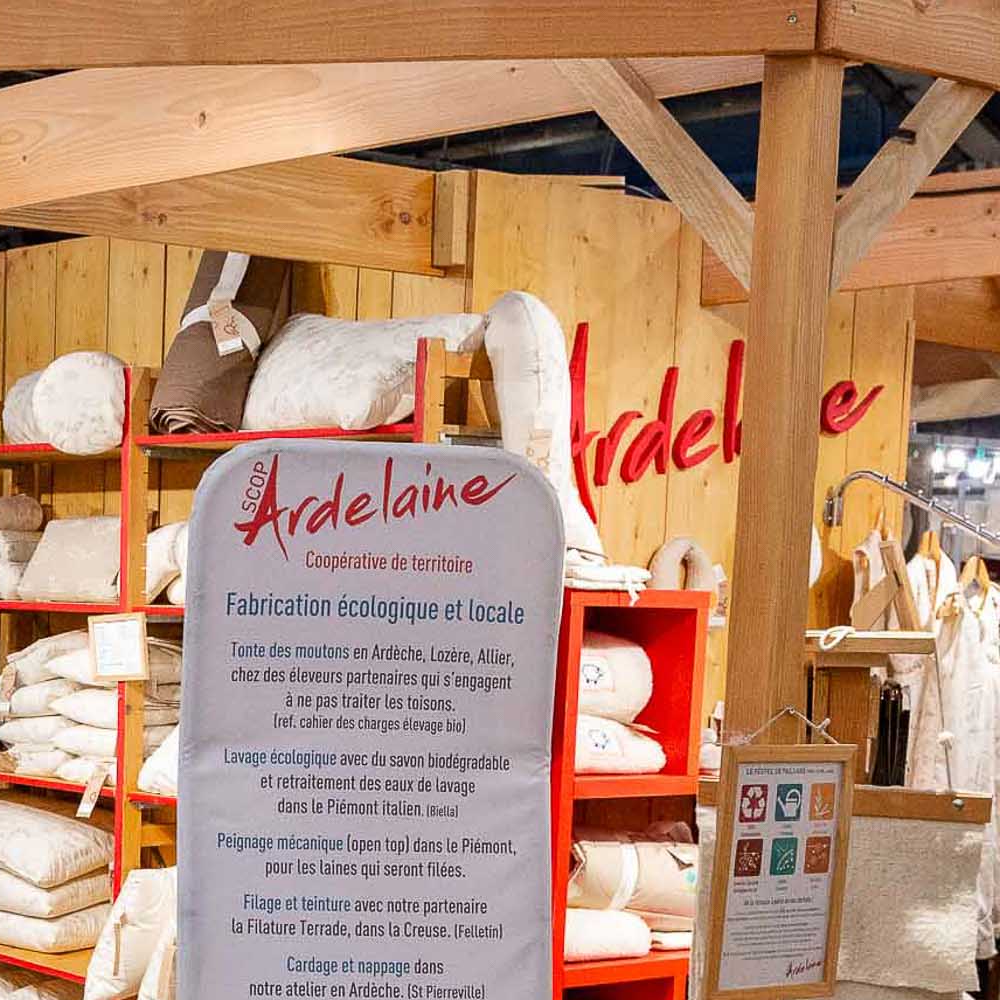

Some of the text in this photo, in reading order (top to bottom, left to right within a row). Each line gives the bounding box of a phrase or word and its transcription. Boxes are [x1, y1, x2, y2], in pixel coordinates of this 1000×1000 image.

[569, 322, 884, 524] Ardele
[242, 461, 268, 514] SCOP
[234, 453, 517, 561] Ardelaine
[306, 550, 473, 574] Coopérative de territoire
[227, 592, 524, 625] Fabrication écologique et locale
[231, 641, 514, 668] Tonte des moutons en Ardèche, Lozère, Allier,
[231, 666, 512, 693] chez des éleveurs partenaires qui s'engagent
[286, 691, 455, 712] à ne pas traiter les toisons.
[300, 714, 334, 729] cahier
[336, 715, 355, 730] des
[358, 716, 400, 733] charges
[403, 717, 443, 735] élevage
[224, 748, 510, 773] Lavage écologique avec du savon biodégradable
[260, 774, 475, 797] et retraitement des eaux de lavage
[278, 797, 308, 814] dans
[312, 798, 323, 814] le
[327, 798, 379, 816] Piémont
[382, 800, 424, 817] italien.
[218, 832, 516, 856] Peignage mécanique (open top) dans le Piémont,
[265, 858, 466, 880] pour les laines qui seront filées.
[244, 894, 487, 917] Filage et teinture avec notre partenaire
[232, 917, 243, 934] la
[247, 918, 296, 936] Filature
[300, 919, 351, 939] Terrade,
[355, 920, 385, 937] dans
[389, 921, 400, 938] la
[402, 921, 451, 940] Creuse.
[287, 956, 444, 978] Cardage et nappage dans
[249, 981, 282, 996] notre
[285, 981, 327, 998] atelier
[330, 984, 345, 997] en
[349, 981, 404, 998] Ardèche.
